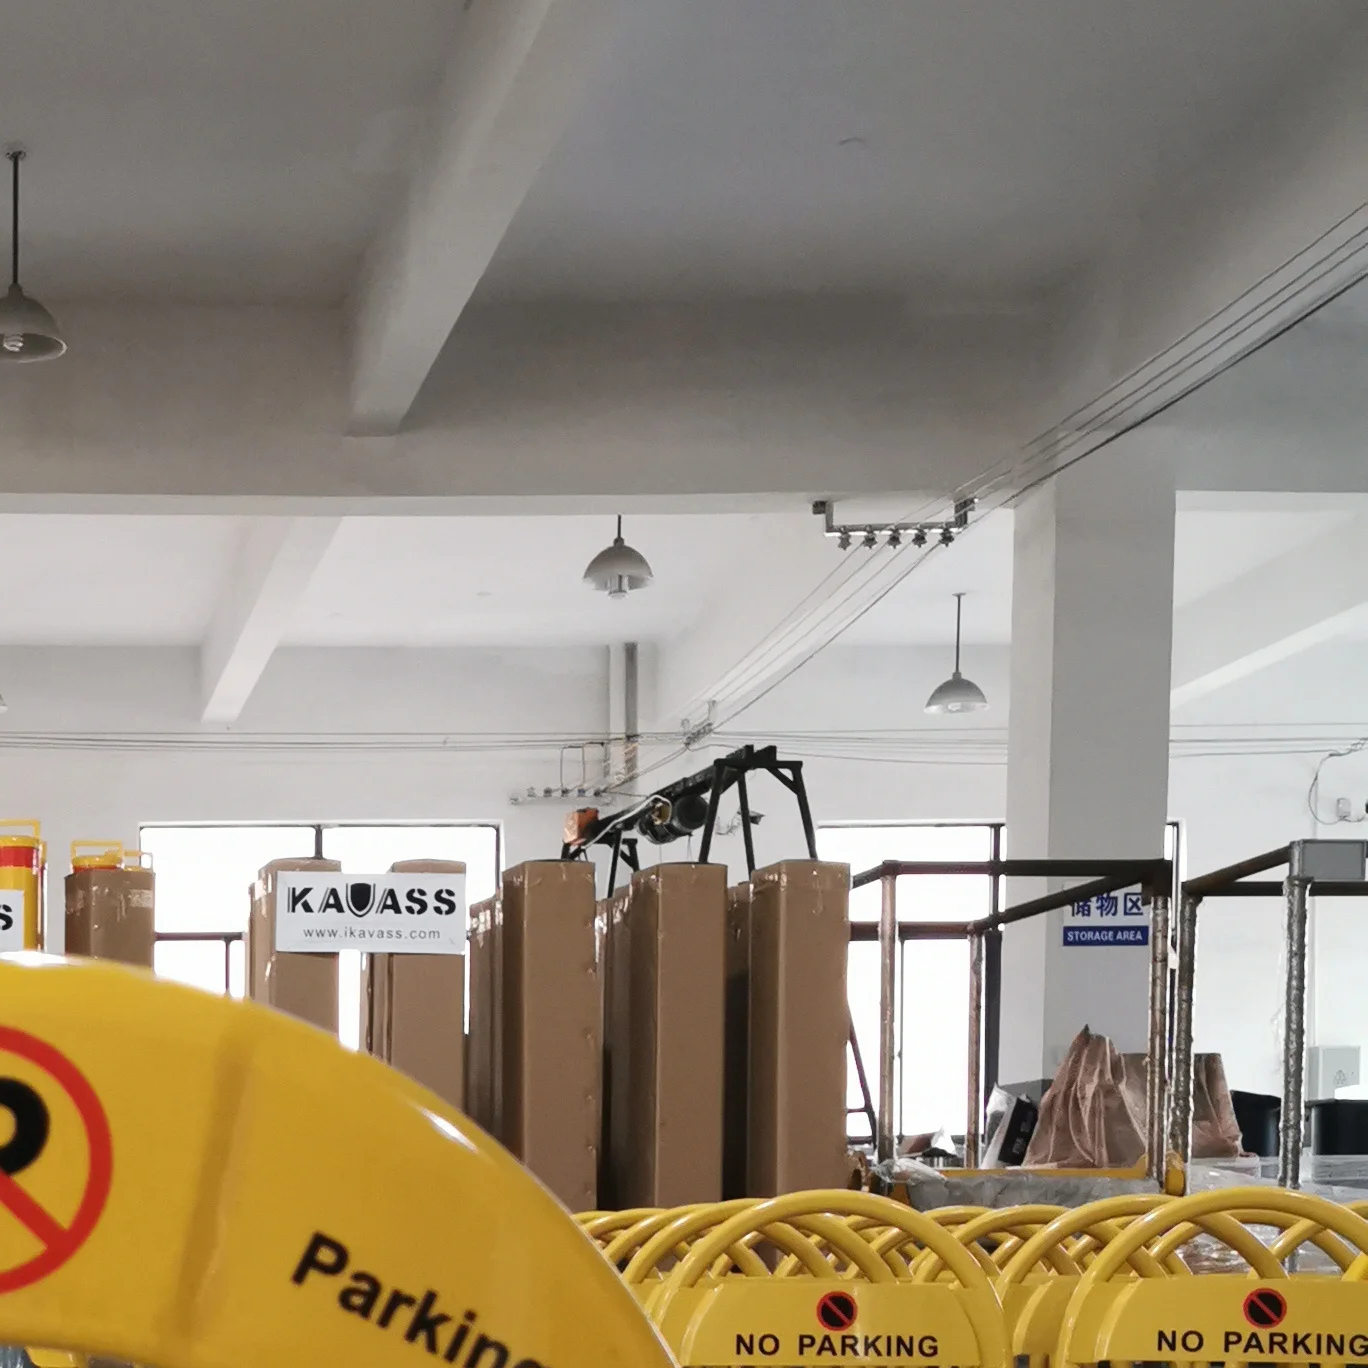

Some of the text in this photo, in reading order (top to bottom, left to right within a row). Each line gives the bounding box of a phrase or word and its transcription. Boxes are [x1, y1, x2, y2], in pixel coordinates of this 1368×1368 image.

[303, 926, 441, 940] www.ikavass.com
[1067, 931, 1143, 942] STORAGE AREA
[735, 1333, 939, 1358] NO PARKING
[1157, 1330, 1368, 1357] NO PARKING
